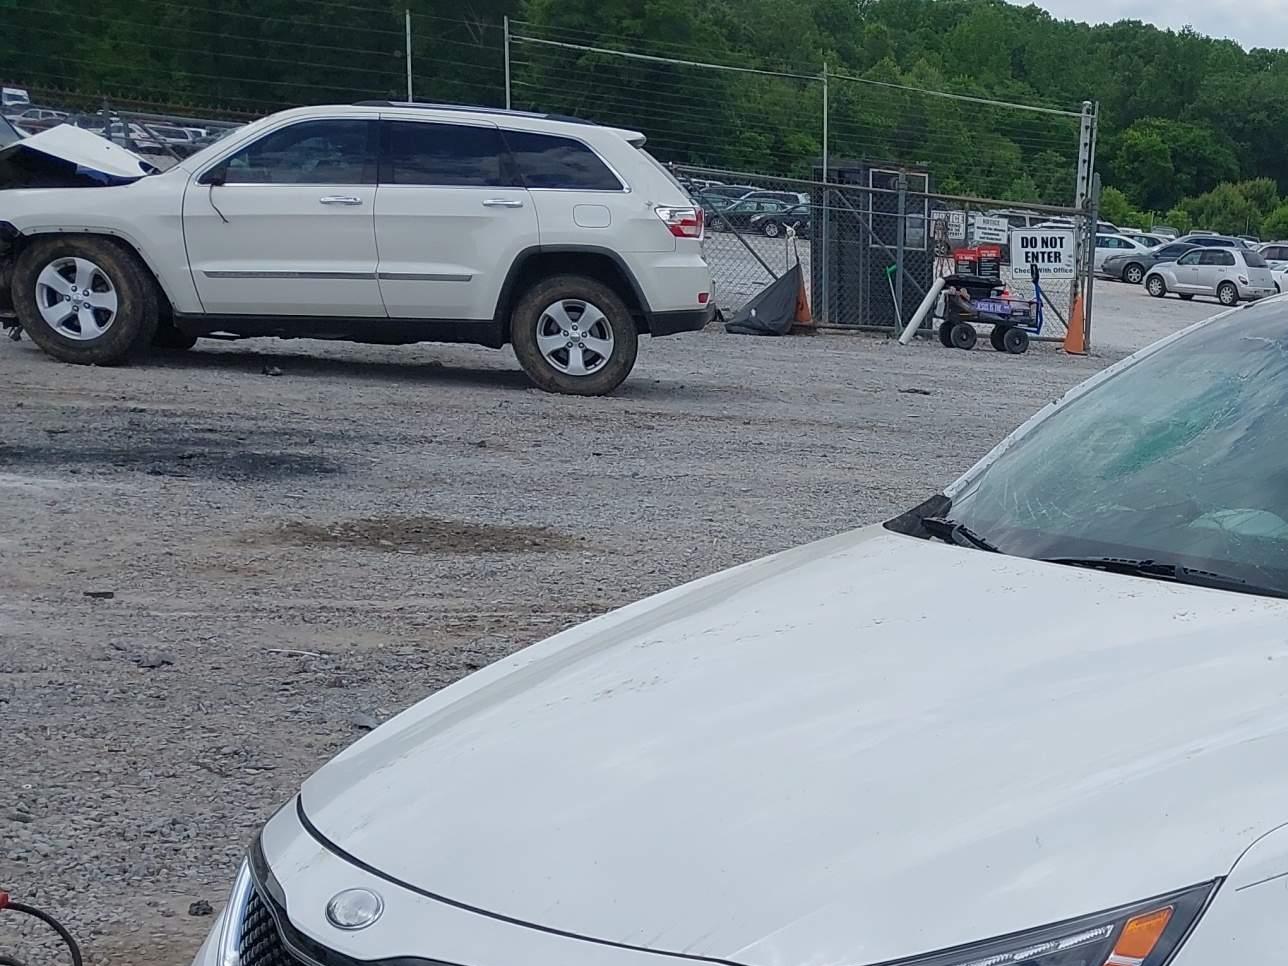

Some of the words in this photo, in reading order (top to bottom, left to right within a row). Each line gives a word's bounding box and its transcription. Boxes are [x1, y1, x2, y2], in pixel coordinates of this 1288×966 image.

[1021, 236, 1038, 249] DO
[1041, 236, 1065, 249] NOT
[1025, 251, 1062, 263] ENTER
